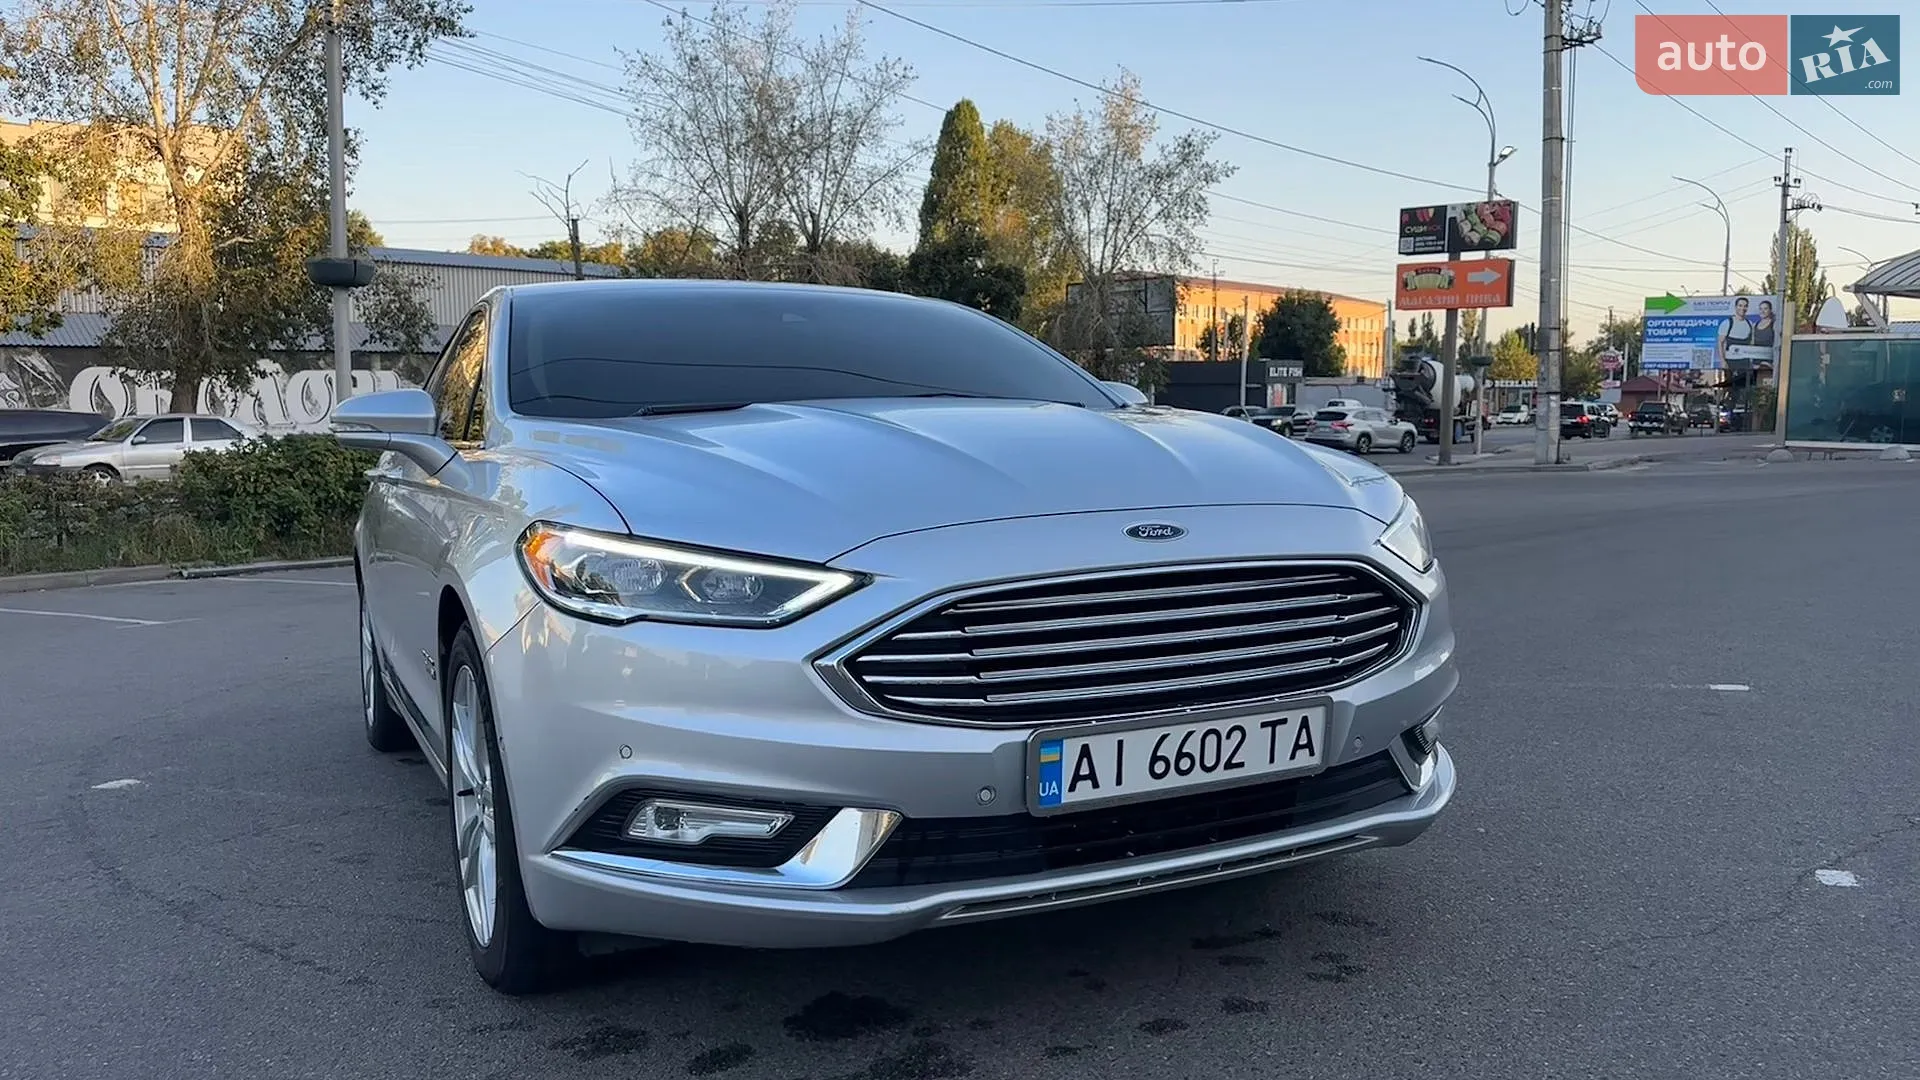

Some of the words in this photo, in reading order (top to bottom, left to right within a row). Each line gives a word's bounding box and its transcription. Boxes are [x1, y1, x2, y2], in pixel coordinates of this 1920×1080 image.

[1400, 294, 1460, 307] МАГАЗИН
[1466, 293, 1501, 305] ПИВА
[1646, 318, 1719, 328] ОРТОПЕДИЧНІ
[1646, 328, 1687, 336] ТОВАРИ
[1269, 367, 1287, 377] ELITE
[1289, 367, 1303, 377] FISH
[1138, 525, 1175, 537] Ford
[1068, 738, 1125, 793] AI
[1149, 724, 1247, 780] 6602
[1260, 714, 1316, 765] TA
[1039, 781, 1059, 797] UA
